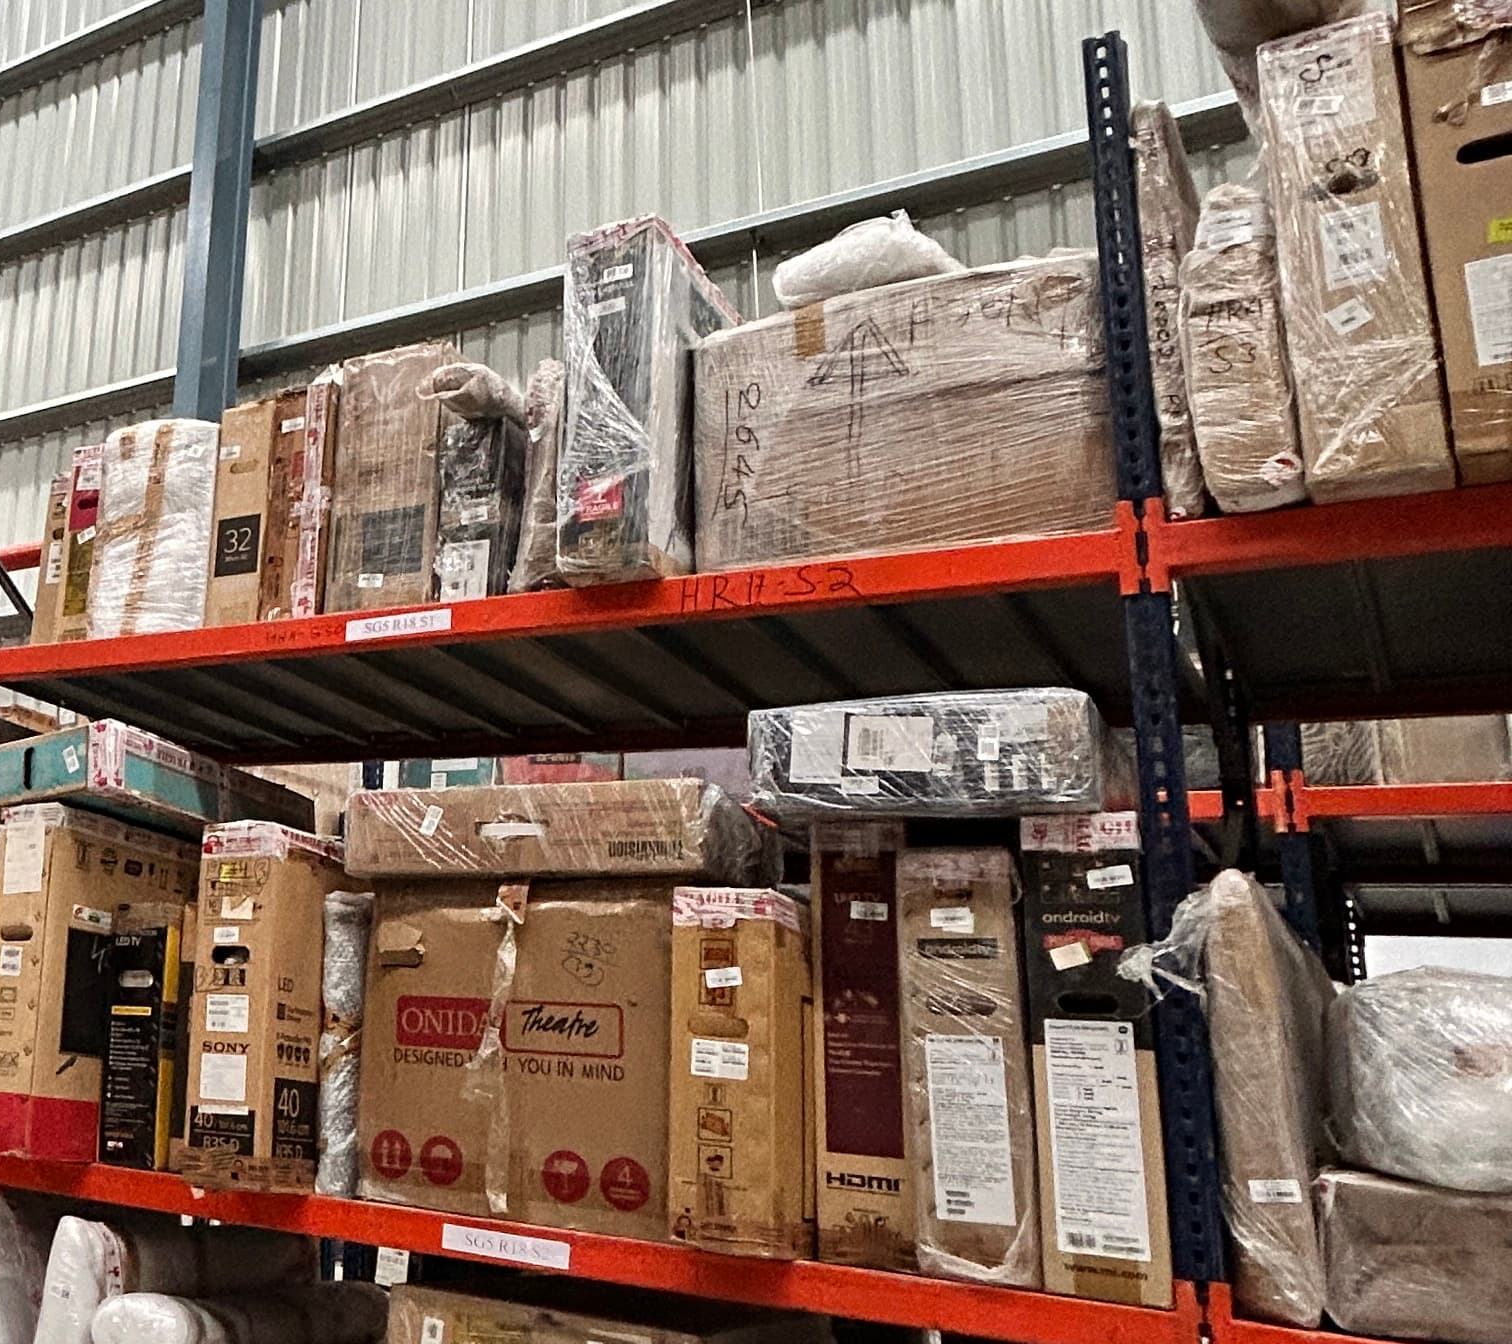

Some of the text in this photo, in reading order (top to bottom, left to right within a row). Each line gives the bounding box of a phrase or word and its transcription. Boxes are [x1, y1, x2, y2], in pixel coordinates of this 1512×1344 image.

[223, 527, 252, 554] 32
[1042, 910, 1121, 926] androidtv
[115, 936, 143, 947] LED TV
[278, 977, 294, 993] LED
[401, 1007, 490, 1037] ONIDA
[522, 1005, 599, 1040] Theatre
[203, 1041, 250, 1054] SONY
[393, 1048, 464, 1068] DESIGNED
[518, 1058, 552, 1075] YOU
[557, 1061, 575, 1078] IN
[581, 1064, 626, 1082] MIND
[279, 1087, 300, 1117] 40
[194, 1113, 214, 1128] 40
[826, 1171, 900, 1192] HDMI
